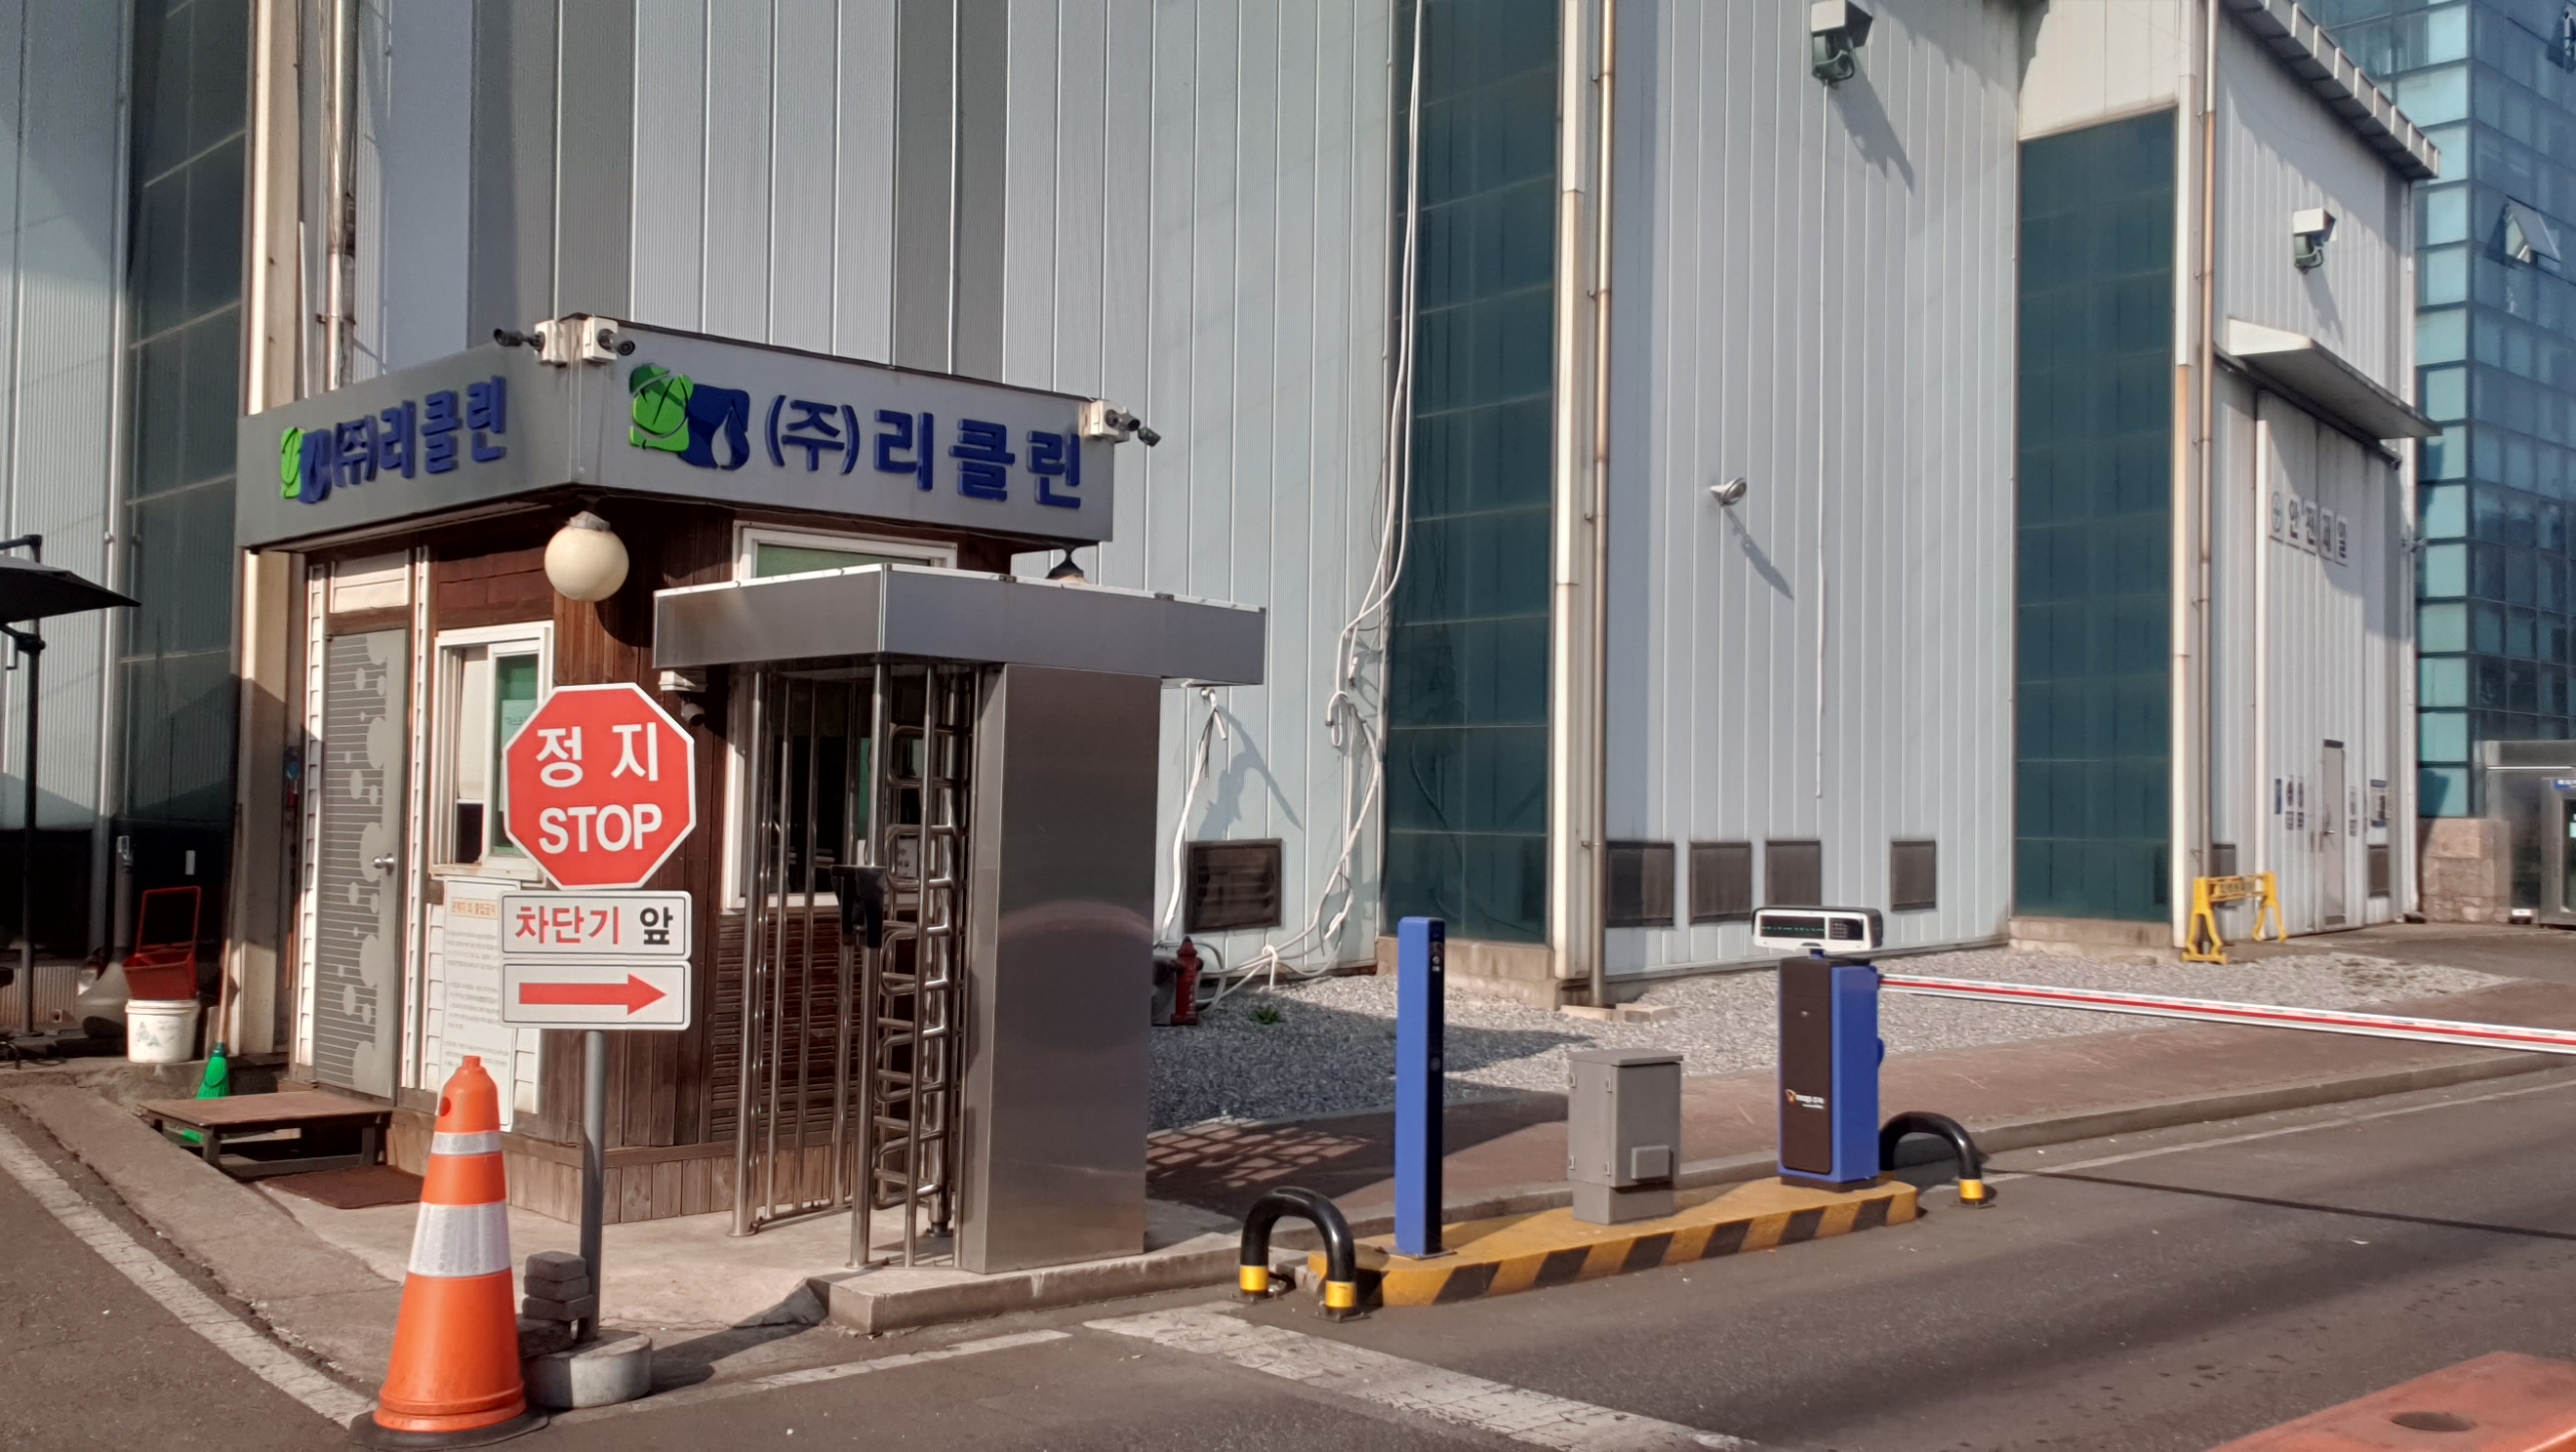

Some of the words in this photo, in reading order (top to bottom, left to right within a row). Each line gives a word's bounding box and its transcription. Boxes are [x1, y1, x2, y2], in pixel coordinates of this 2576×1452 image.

[333, 375, 506, 488] (주)리클린
[764, 394, 1081, 509] (주)리클린
[538, 803, 663, 855] STOP
[514, 905, 621, 946] 차단기
[639, 907, 673, 946] 앞
